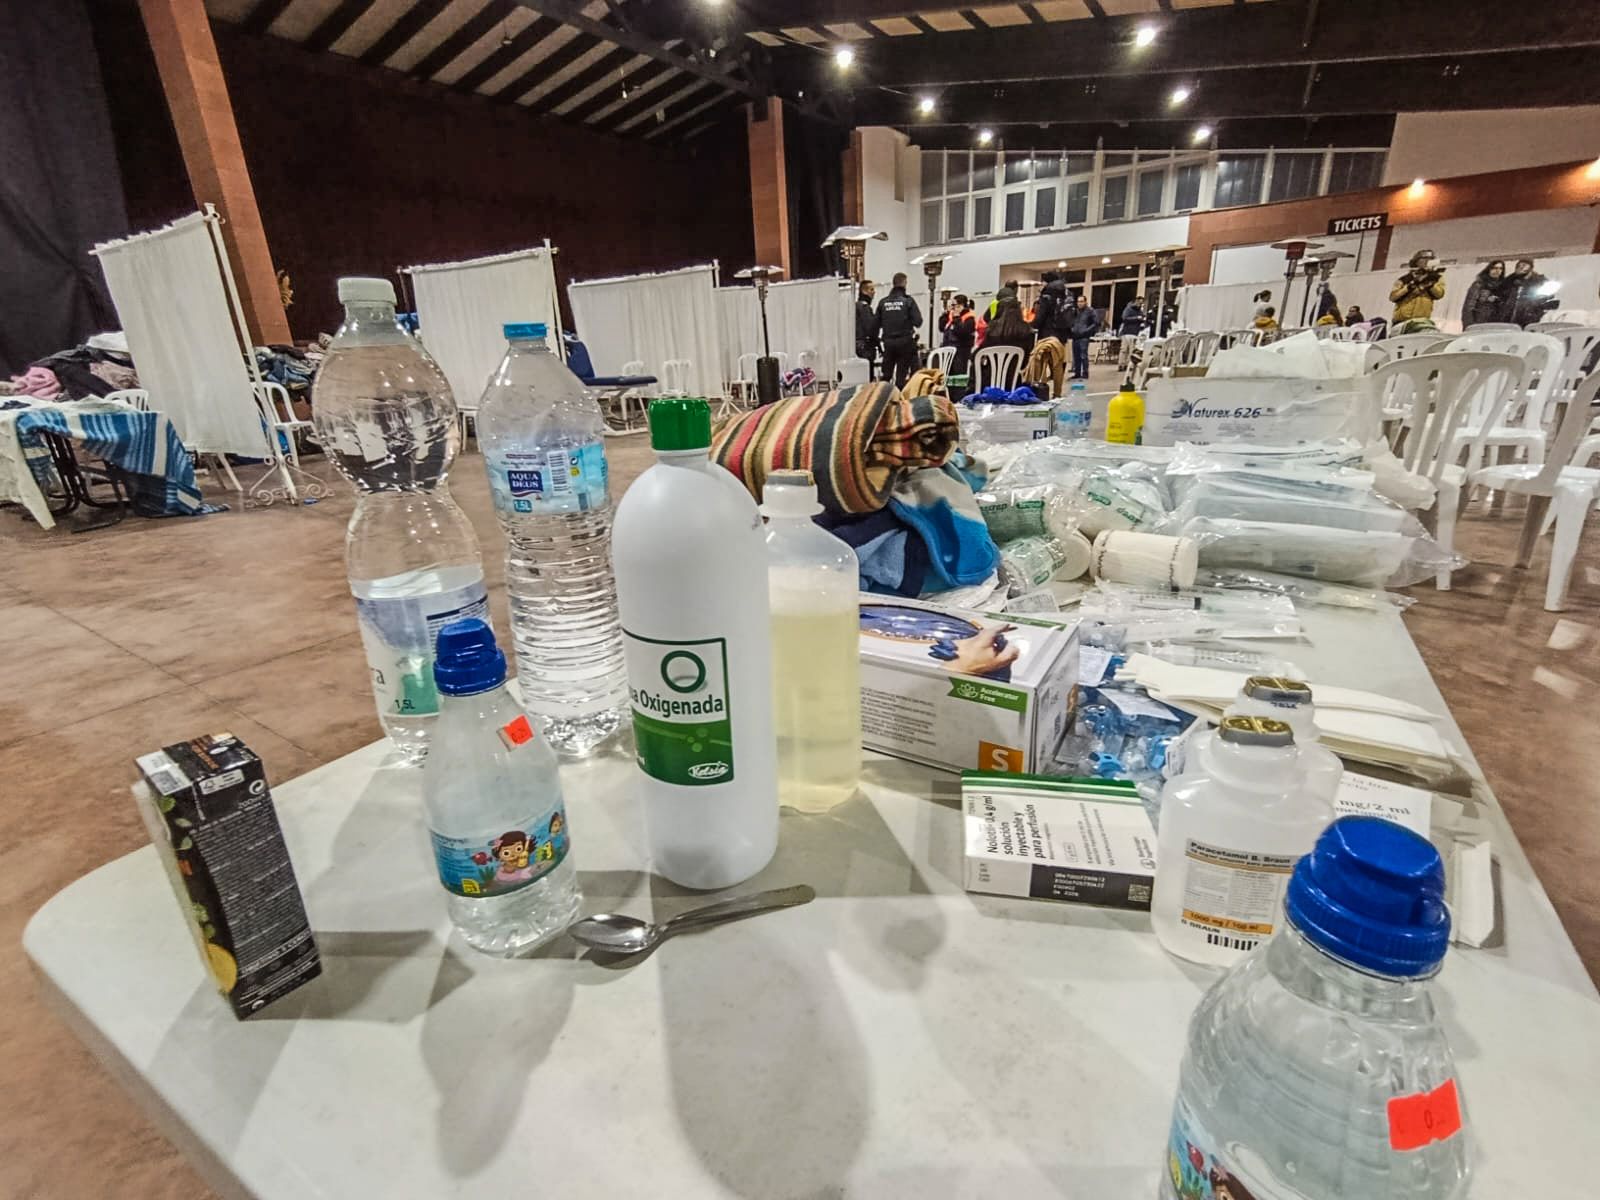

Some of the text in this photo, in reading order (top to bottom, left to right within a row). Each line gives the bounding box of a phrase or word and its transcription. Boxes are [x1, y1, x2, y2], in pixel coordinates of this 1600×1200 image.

[1334, 216, 1382, 233] TICKETS
[1172, 398, 1229, 419] Naturex
[1234, 407, 1262, 418] 626
[1036, 431, 1045, 439] M
[510, 472, 539, 481] AQUA
[512, 480, 539, 488] DEUS
[979, 694, 996, 703] Free
[980, 687, 1020, 701] Accelerator
[640, 690, 724, 718] Oxigenada
[991, 750, 1009, 770] S
[1001, 821, 1014, 856] solución
[1013, 816, 1029, 857] inyectable
[1025, 804, 1046, 860] para perfusión
[1190, 841, 1248, 860] Paracetamol
[1190, 912, 1210, 922] 1000
[1212, 918, 1223, 926] mg
[1232, 922, 1248, 930] 100
